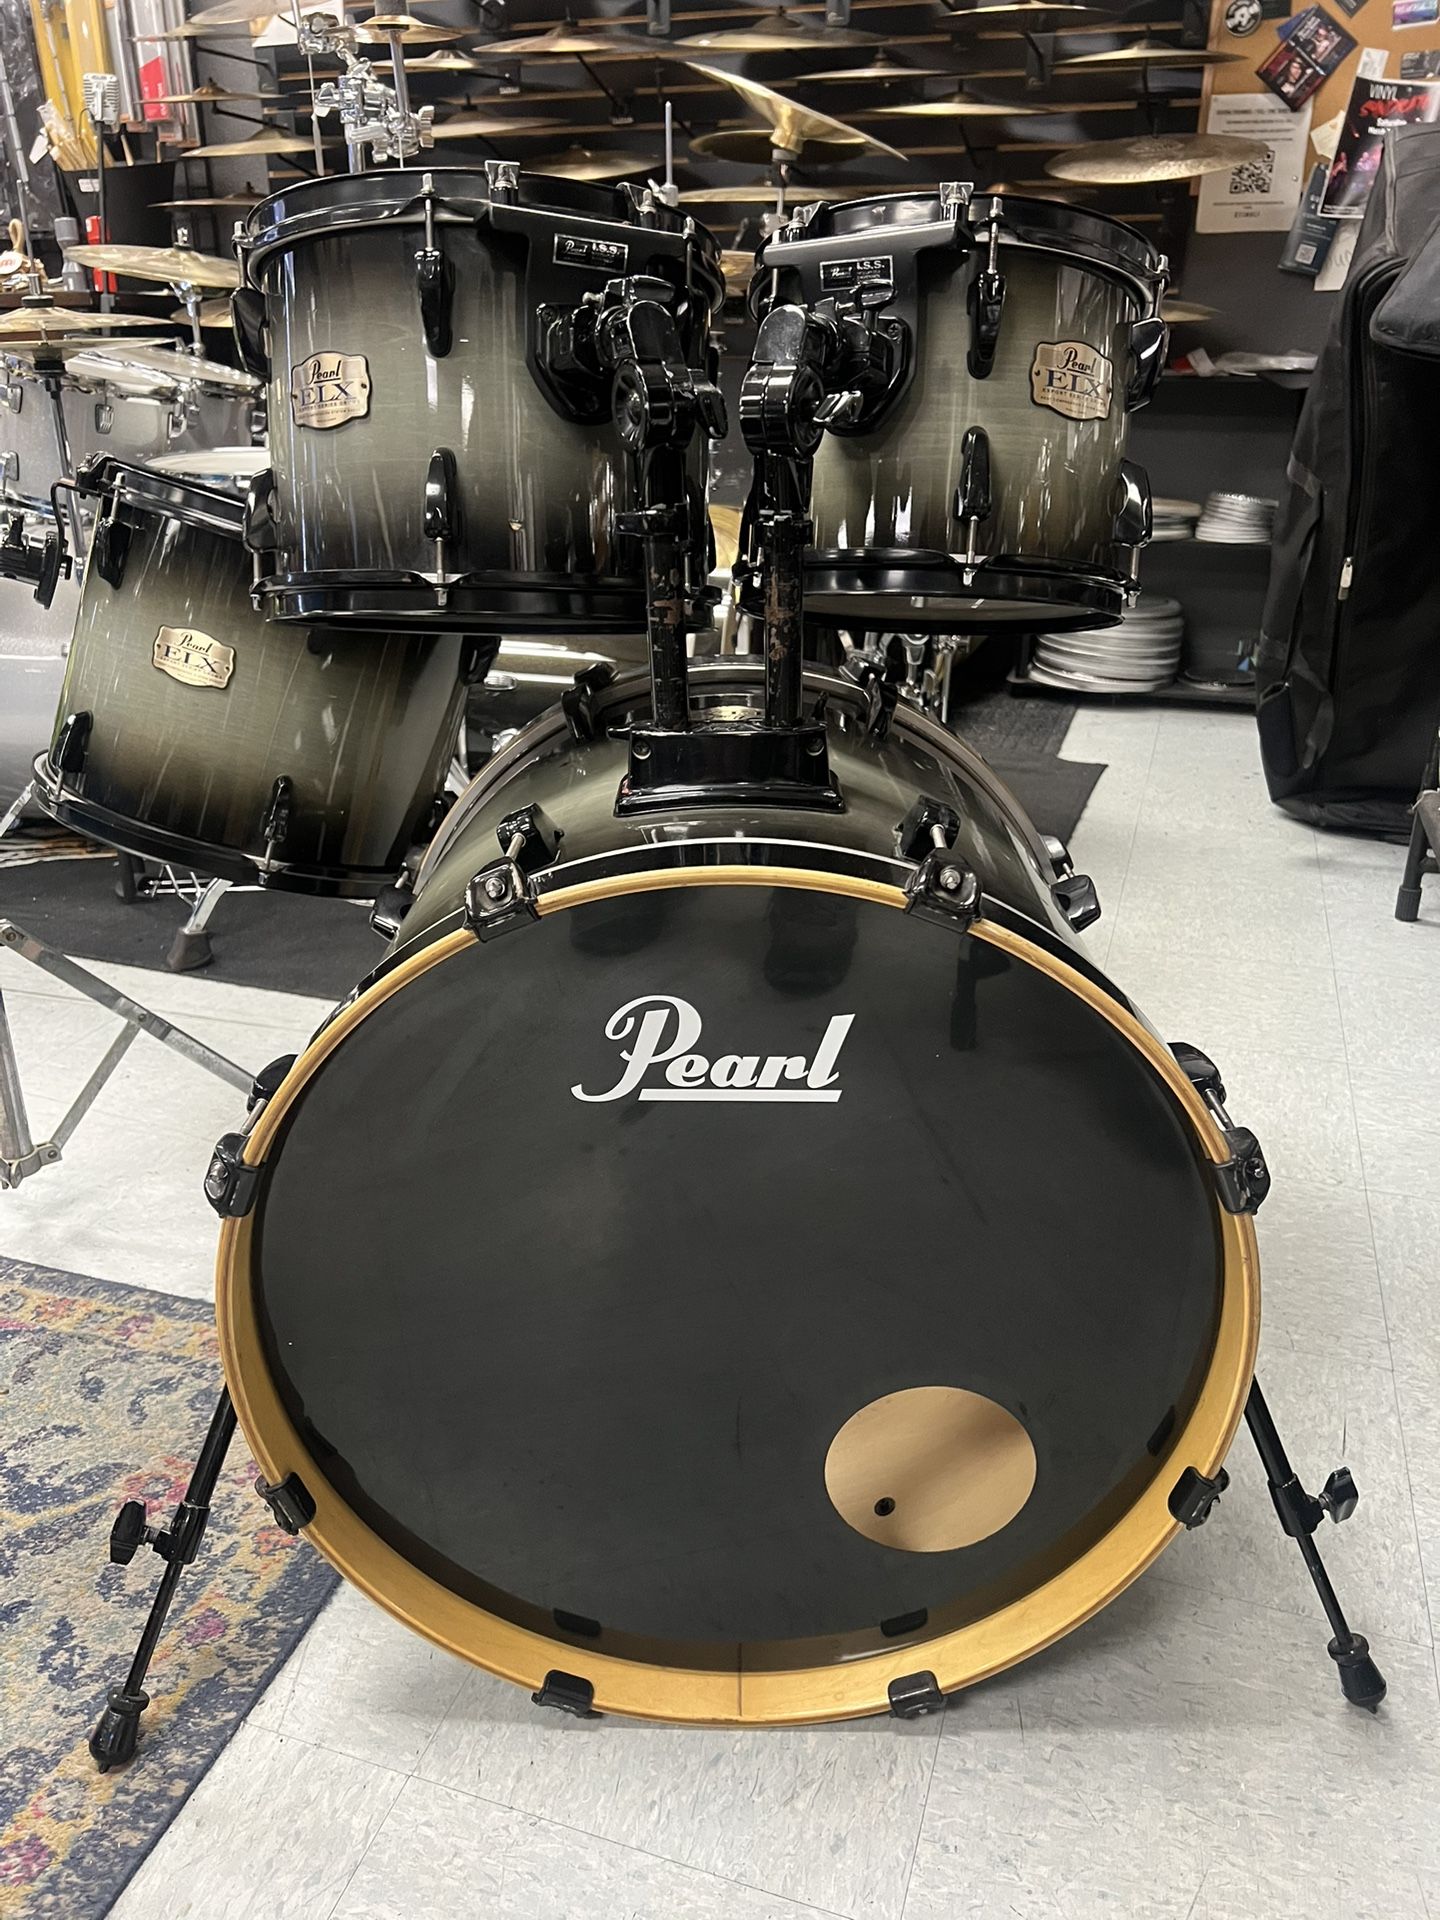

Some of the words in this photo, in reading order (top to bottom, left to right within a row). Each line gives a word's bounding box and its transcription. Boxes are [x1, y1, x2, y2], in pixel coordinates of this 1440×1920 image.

[306, 360, 342, 385] Pearl
[1057, 346, 1097, 374] Pearl
[300, 380, 357, 407] ELX
[1044, 368, 1104, 399] ELX
[176, 632, 214, 654] Pearl
[163, 644, 223, 675] ELX
[570, 994, 856, 1103] Pearl
